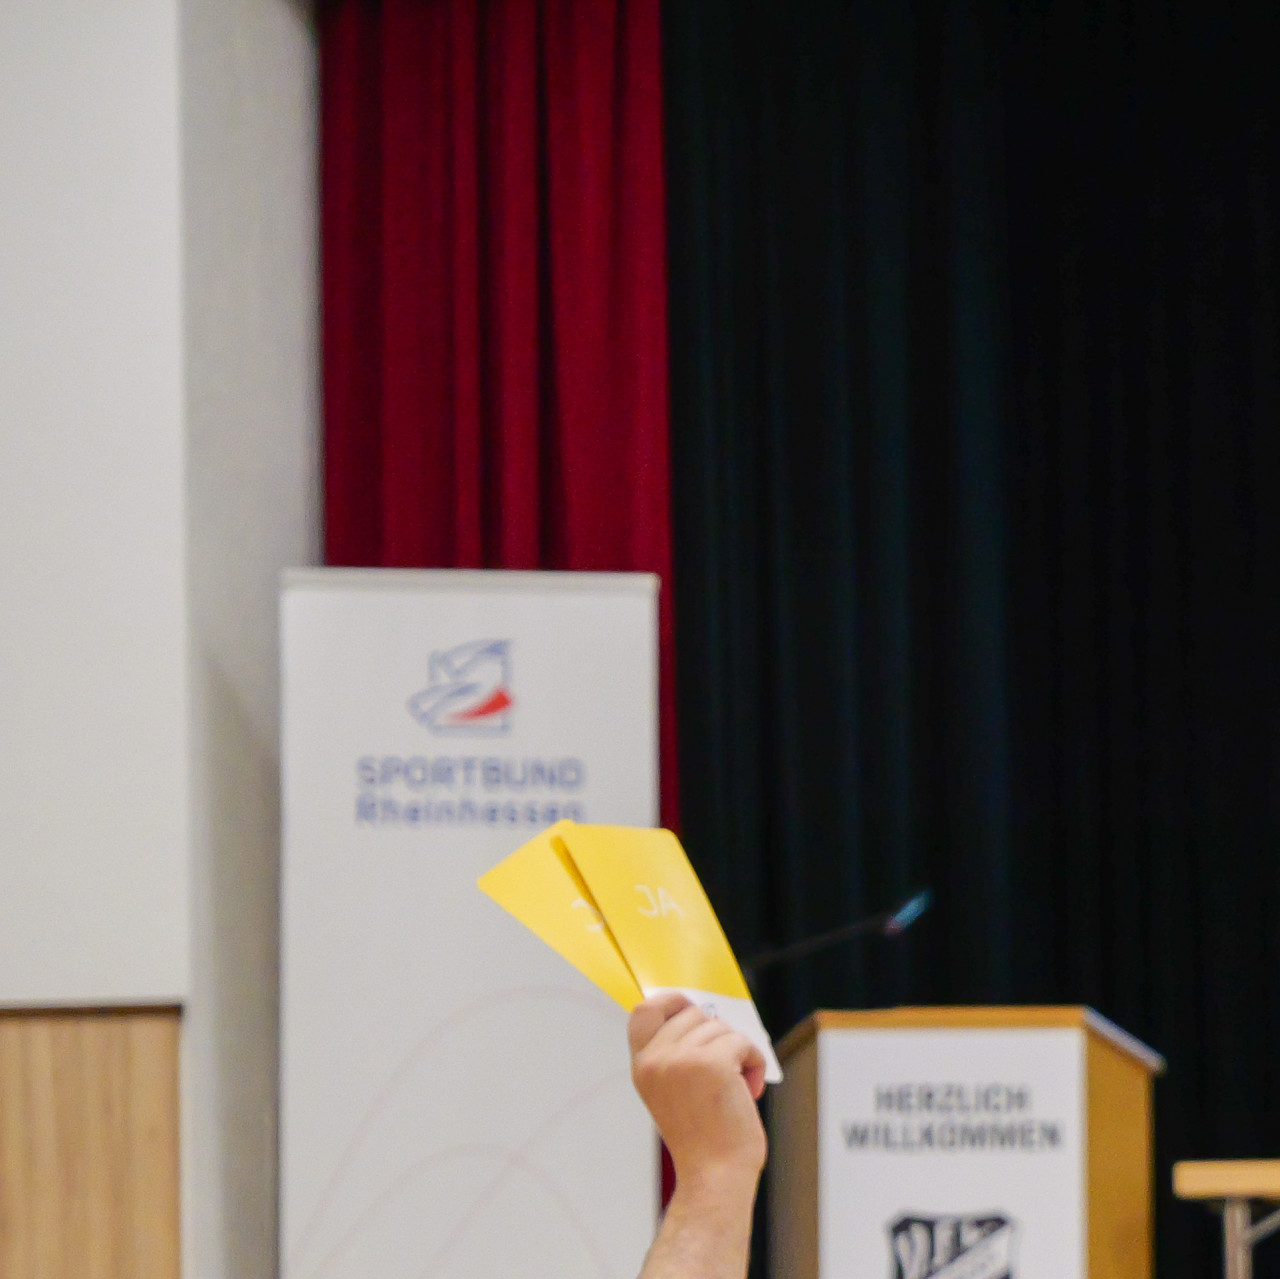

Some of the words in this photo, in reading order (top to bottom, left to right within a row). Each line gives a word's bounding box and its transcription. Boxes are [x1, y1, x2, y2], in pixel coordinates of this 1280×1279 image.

[355, 757, 585, 790] SPORTBUND
[356, 795, 583, 824] Rheinhessen
[634, 884, 685, 919] JA
[874, 1083, 1030, 1113] HERZLICH
[842, 1120, 1065, 1150] WILLKOMMEN
